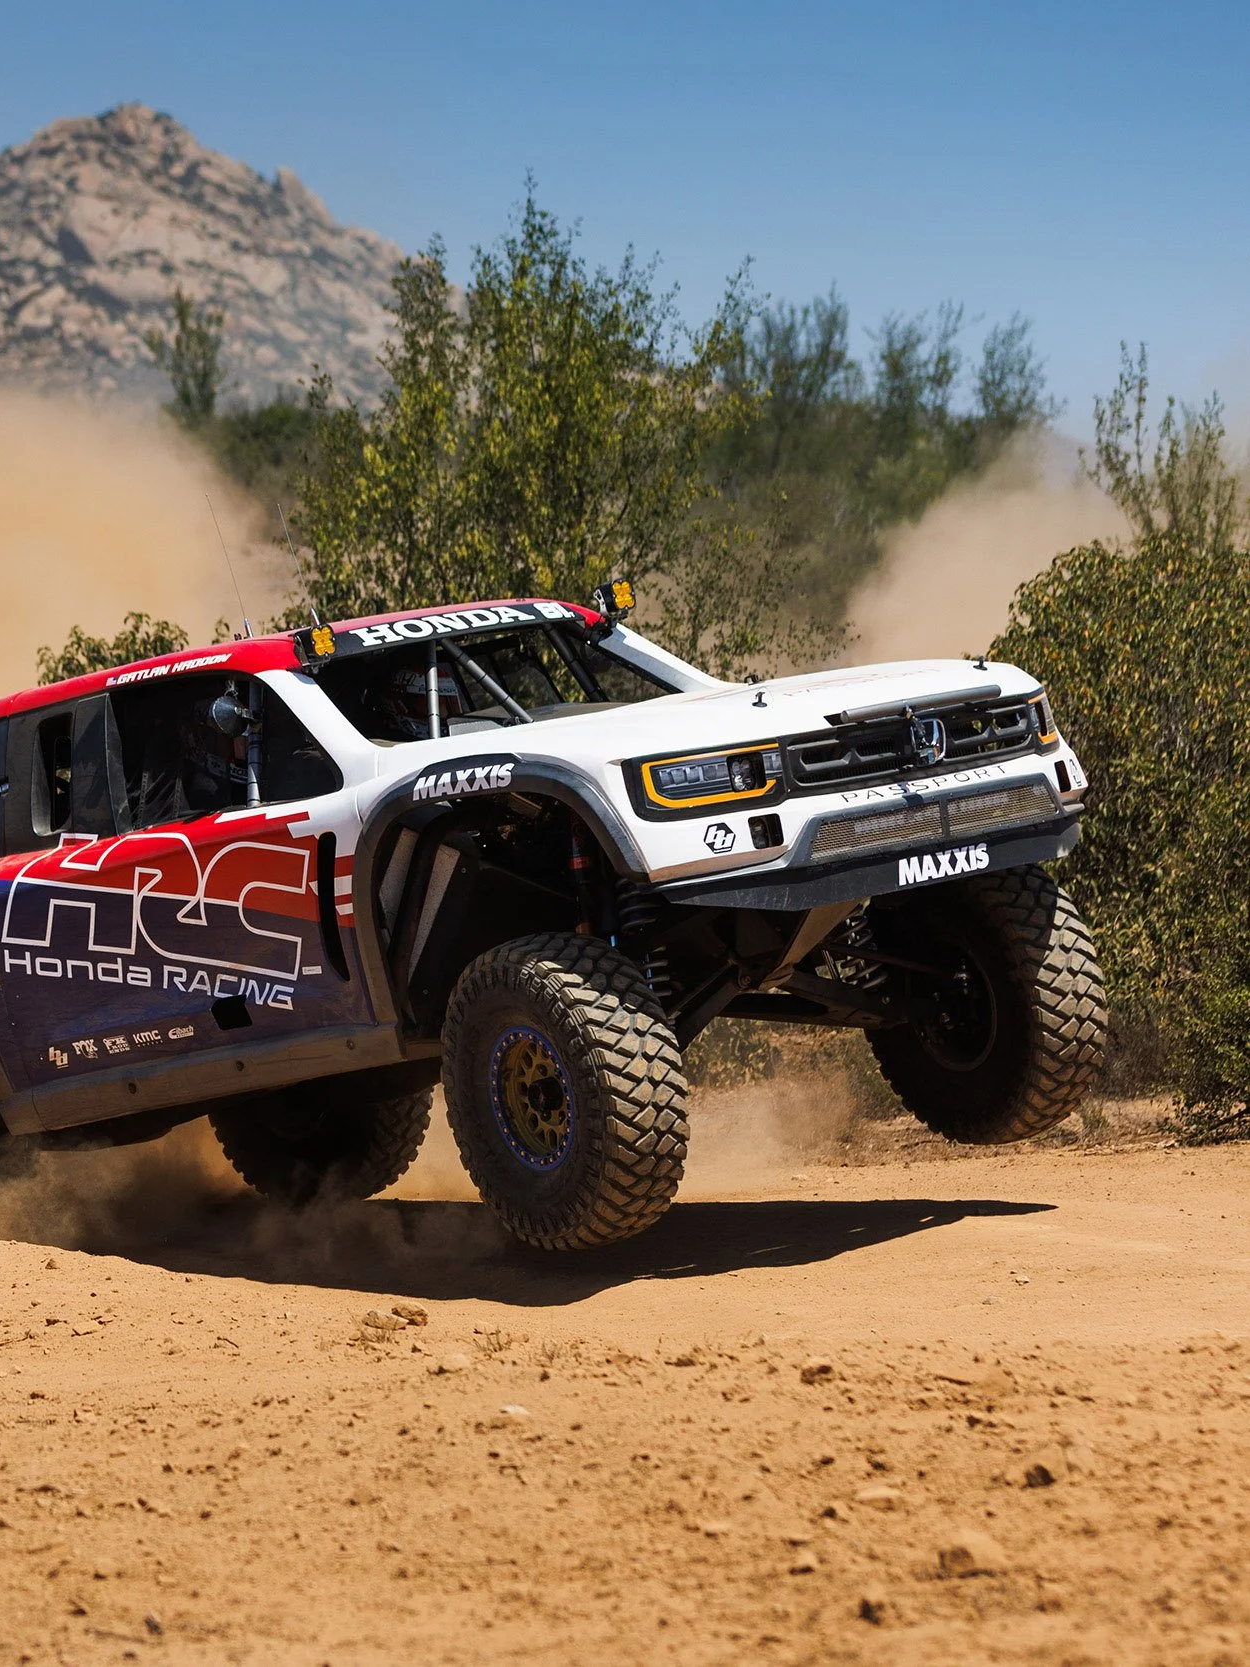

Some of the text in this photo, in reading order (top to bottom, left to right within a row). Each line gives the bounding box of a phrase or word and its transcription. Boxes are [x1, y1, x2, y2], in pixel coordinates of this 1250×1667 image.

[349, 606, 535, 647] HONDA
[412, 763, 515, 801] MAXXIS
[841, 765, 1006, 803] PASSPORT
[898, 843, 990, 886] MAXXIS
[1, 832, 310, 981] HRC
[4, 950, 295, 1010] Honda RACING
[72, 1039, 98, 1057] FOX
